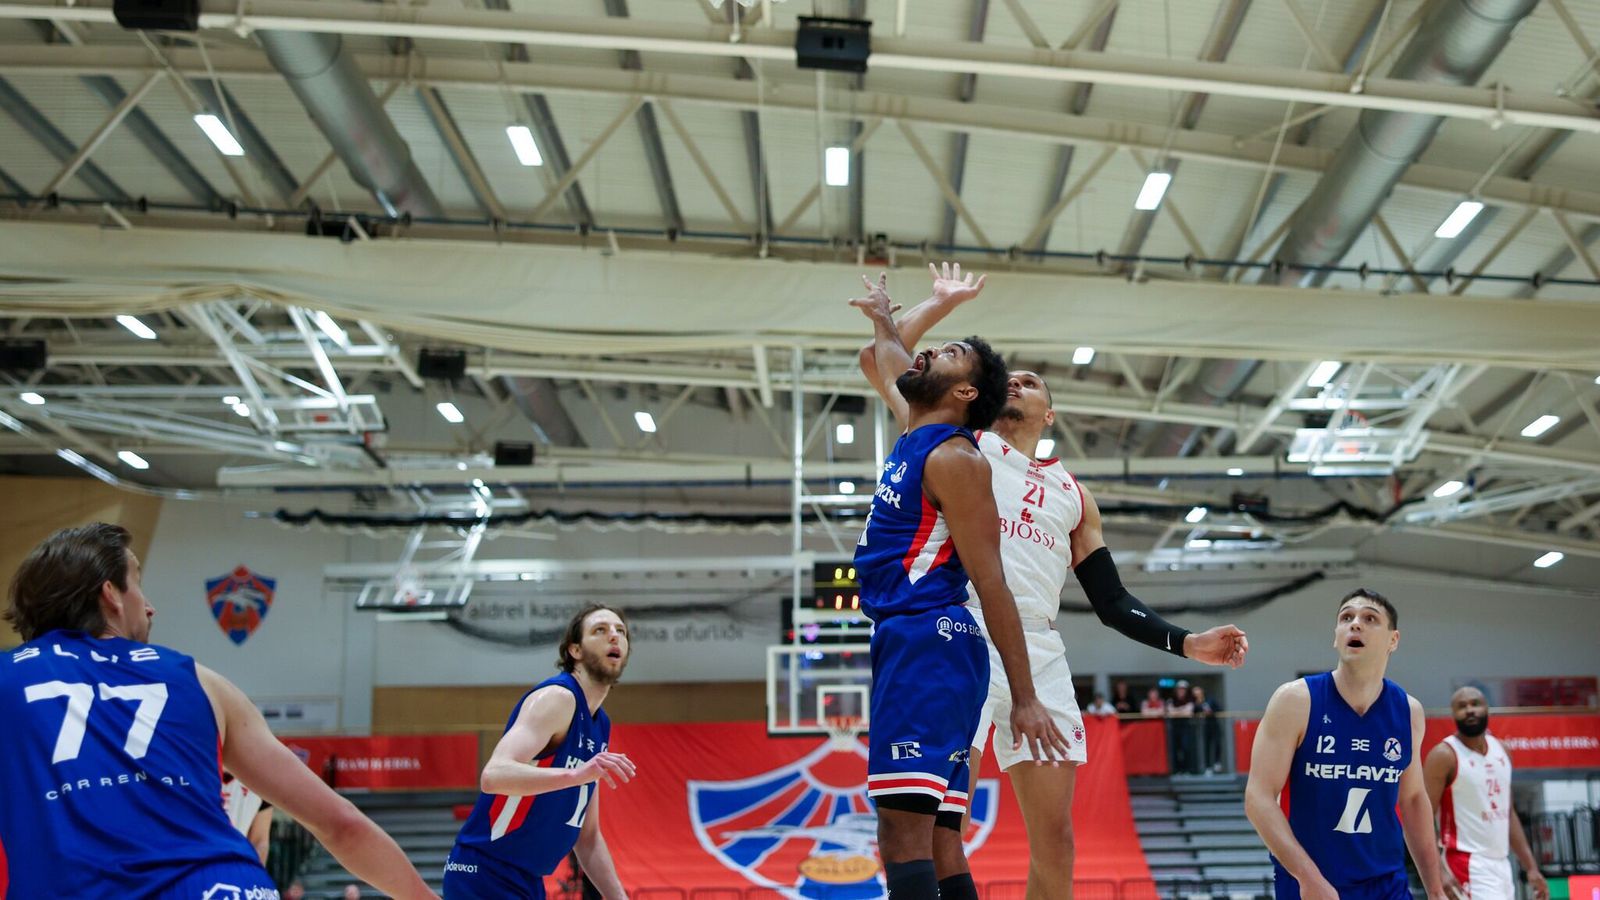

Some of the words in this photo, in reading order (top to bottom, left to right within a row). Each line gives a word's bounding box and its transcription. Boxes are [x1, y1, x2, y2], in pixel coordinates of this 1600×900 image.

[1023, 480, 1045, 508] 21
[24, 680, 169, 765] 77
[1316, 735, 1336, 754] 12
[1486, 779, 1501, 796] 24
